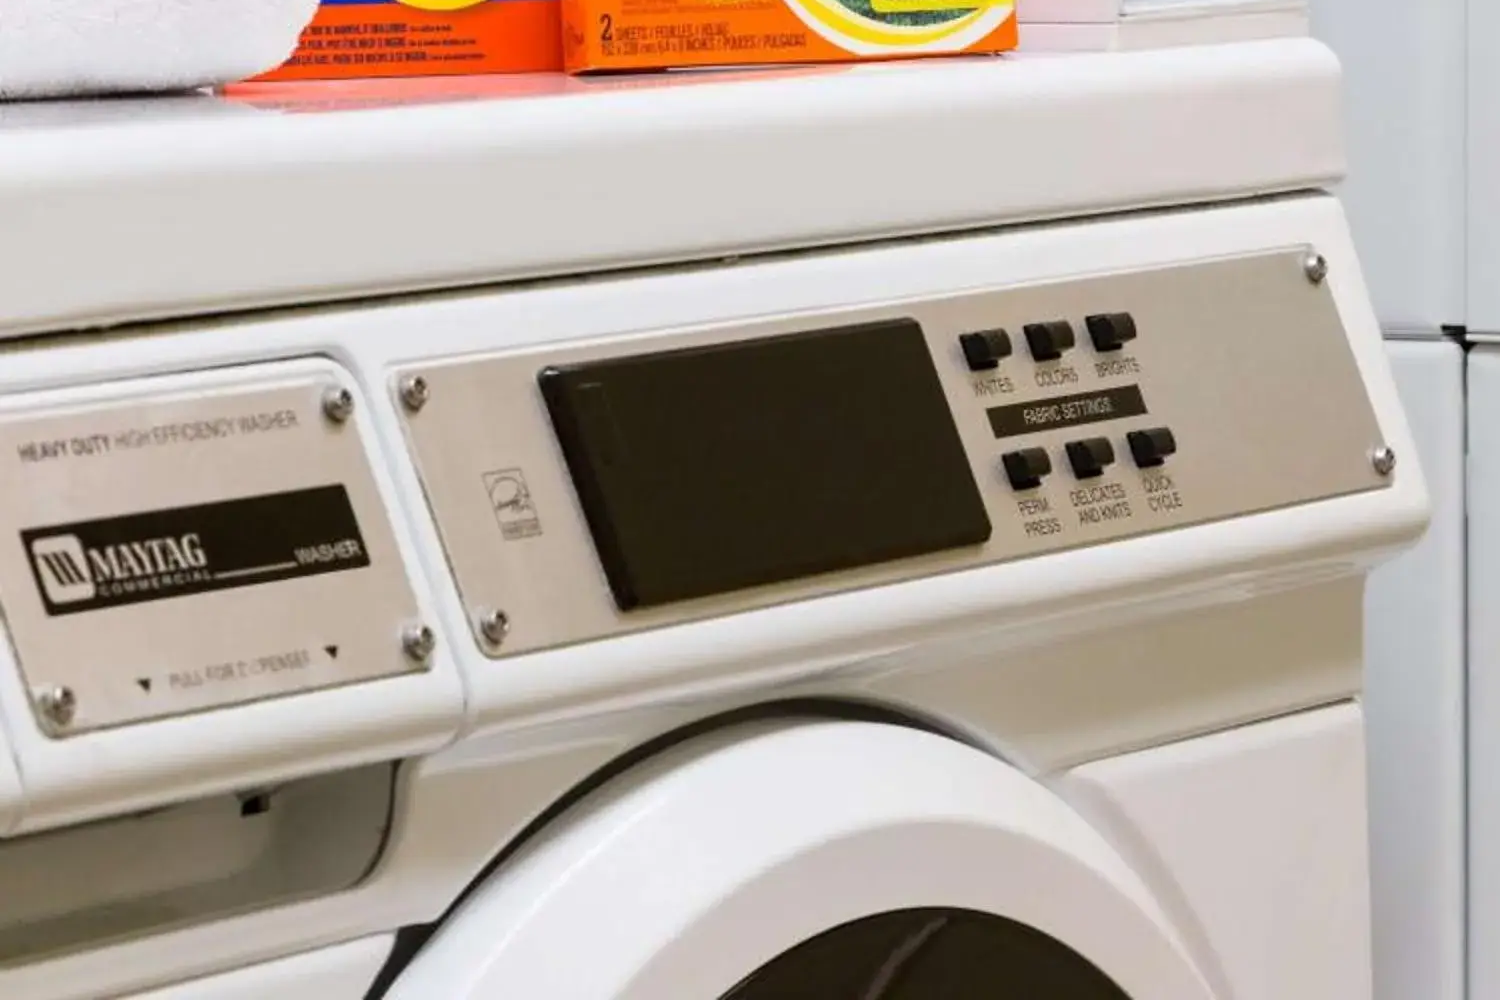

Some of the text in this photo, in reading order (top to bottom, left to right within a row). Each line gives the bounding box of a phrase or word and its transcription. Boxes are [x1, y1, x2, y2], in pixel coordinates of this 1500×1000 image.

[600, 13, 613, 42] 2
[1034, 367, 1079, 388] COLORS
[1023, 404, 1061, 425] FABRIC
[17, 440, 68, 463] HEAVY
[70, 434, 111, 457] DUTY
[151, 417, 237, 446] EFFICIENCY
[238, 409, 299, 433] WASHER
[1069, 483, 1127, 507] DELICATES
[1147, 491, 1183, 513] CYCLE
[1024, 517, 1062, 538] PRESS
[88, 532, 208, 582] MAYTAG
[99, 539, 362, 597] COMMERCIAL WASHER
